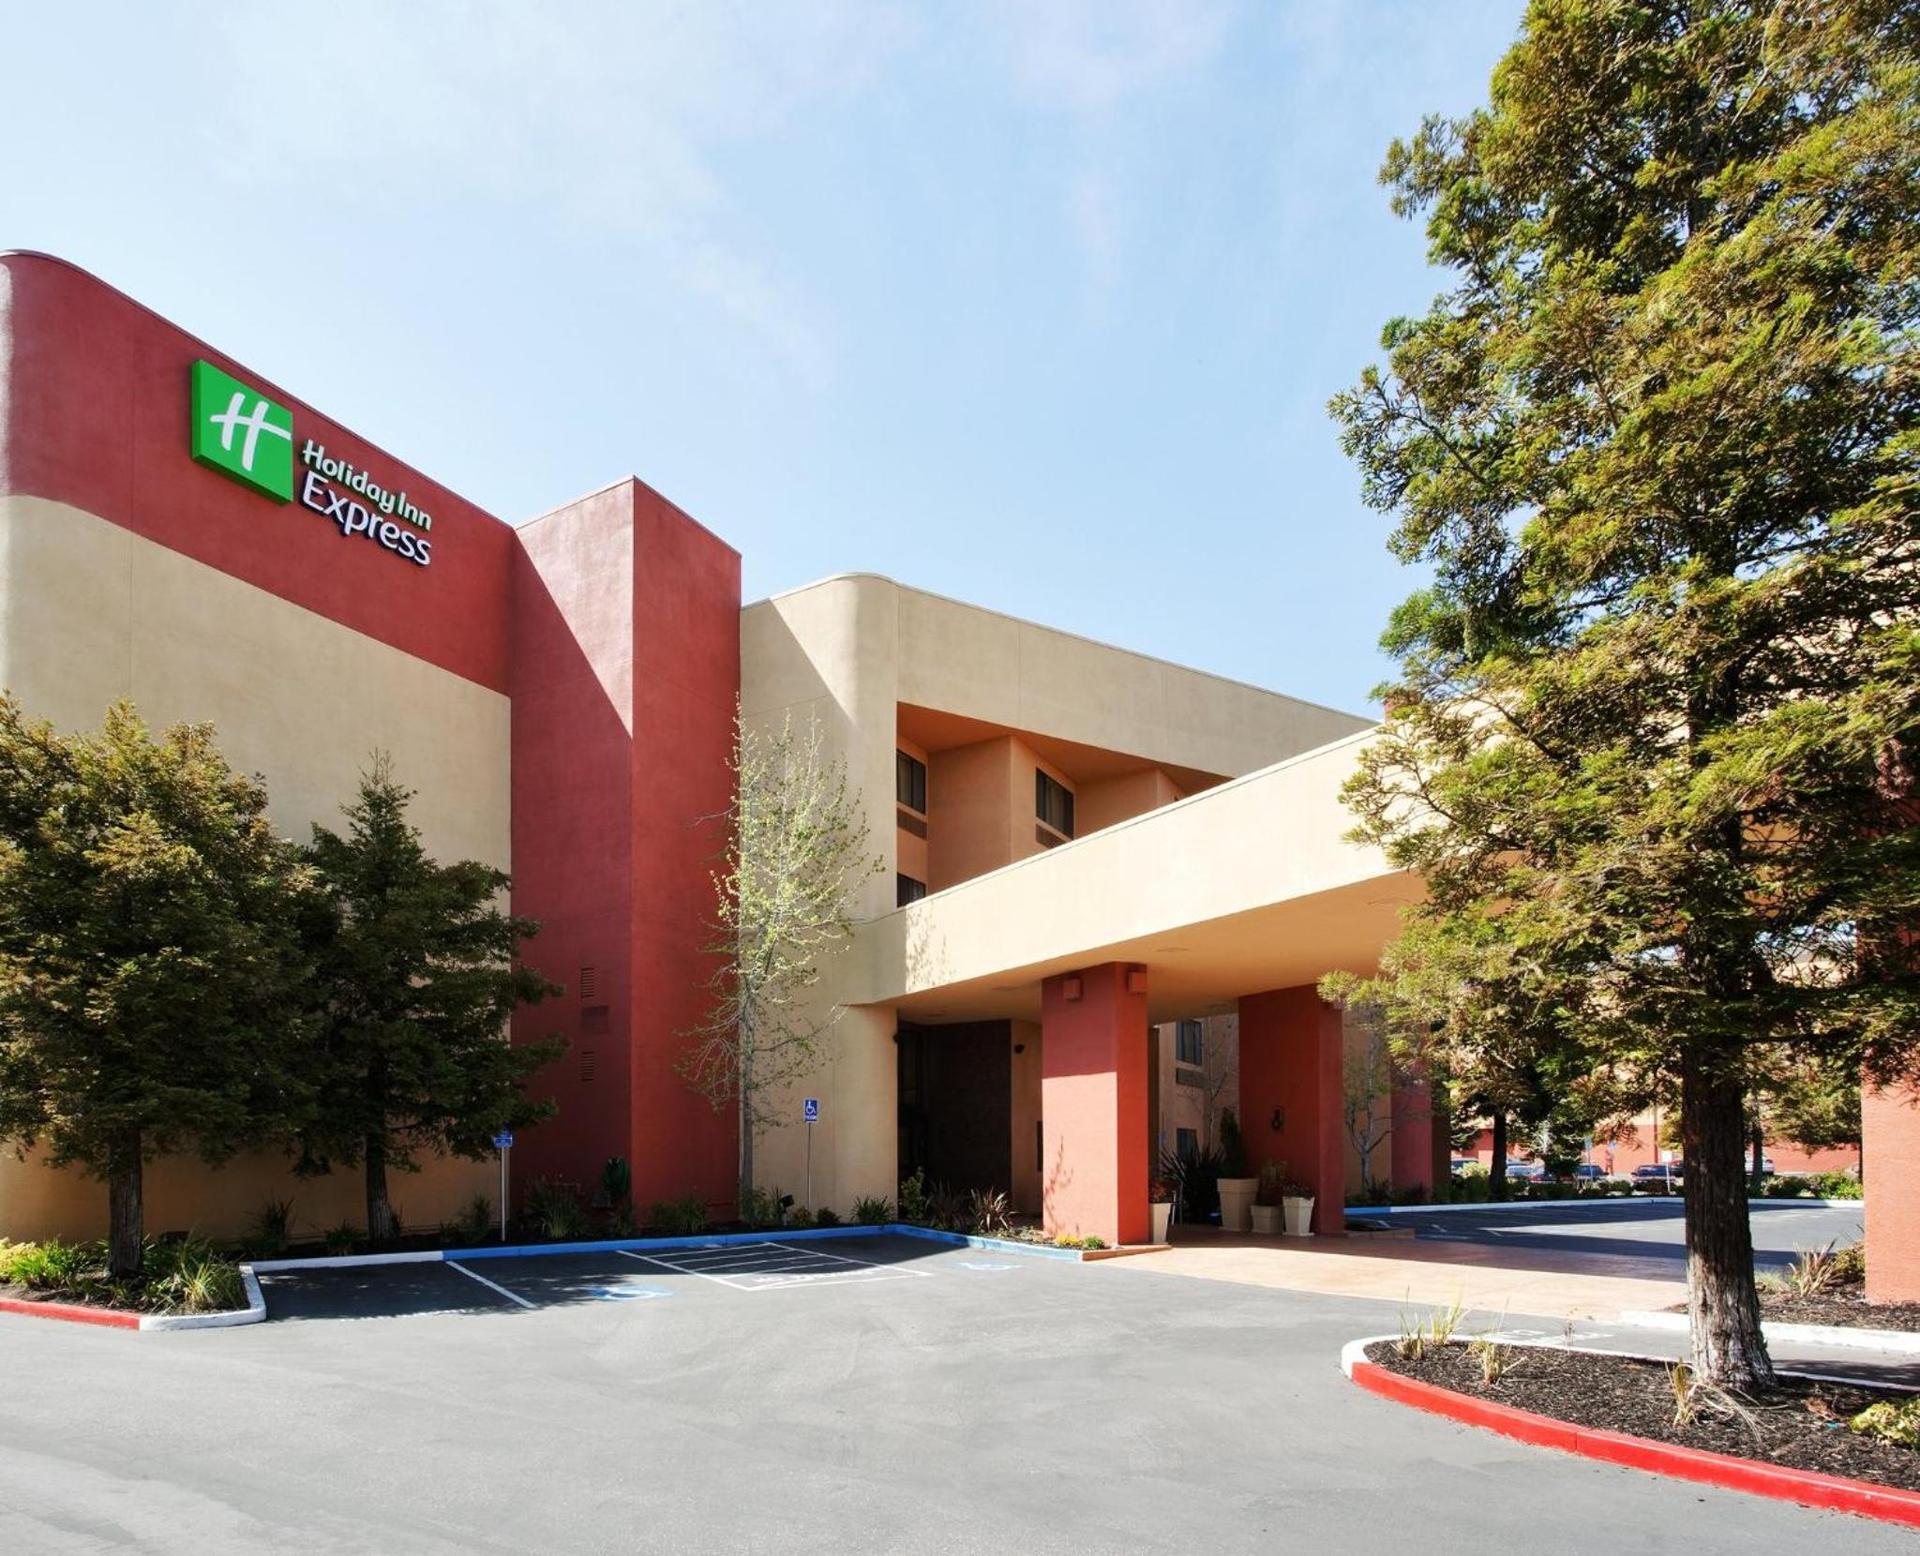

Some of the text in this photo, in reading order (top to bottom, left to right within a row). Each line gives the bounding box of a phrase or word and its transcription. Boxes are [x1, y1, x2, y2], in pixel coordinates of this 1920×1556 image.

[302, 438, 433, 531] Holiday Inn
[302, 469, 433, 567] Express
